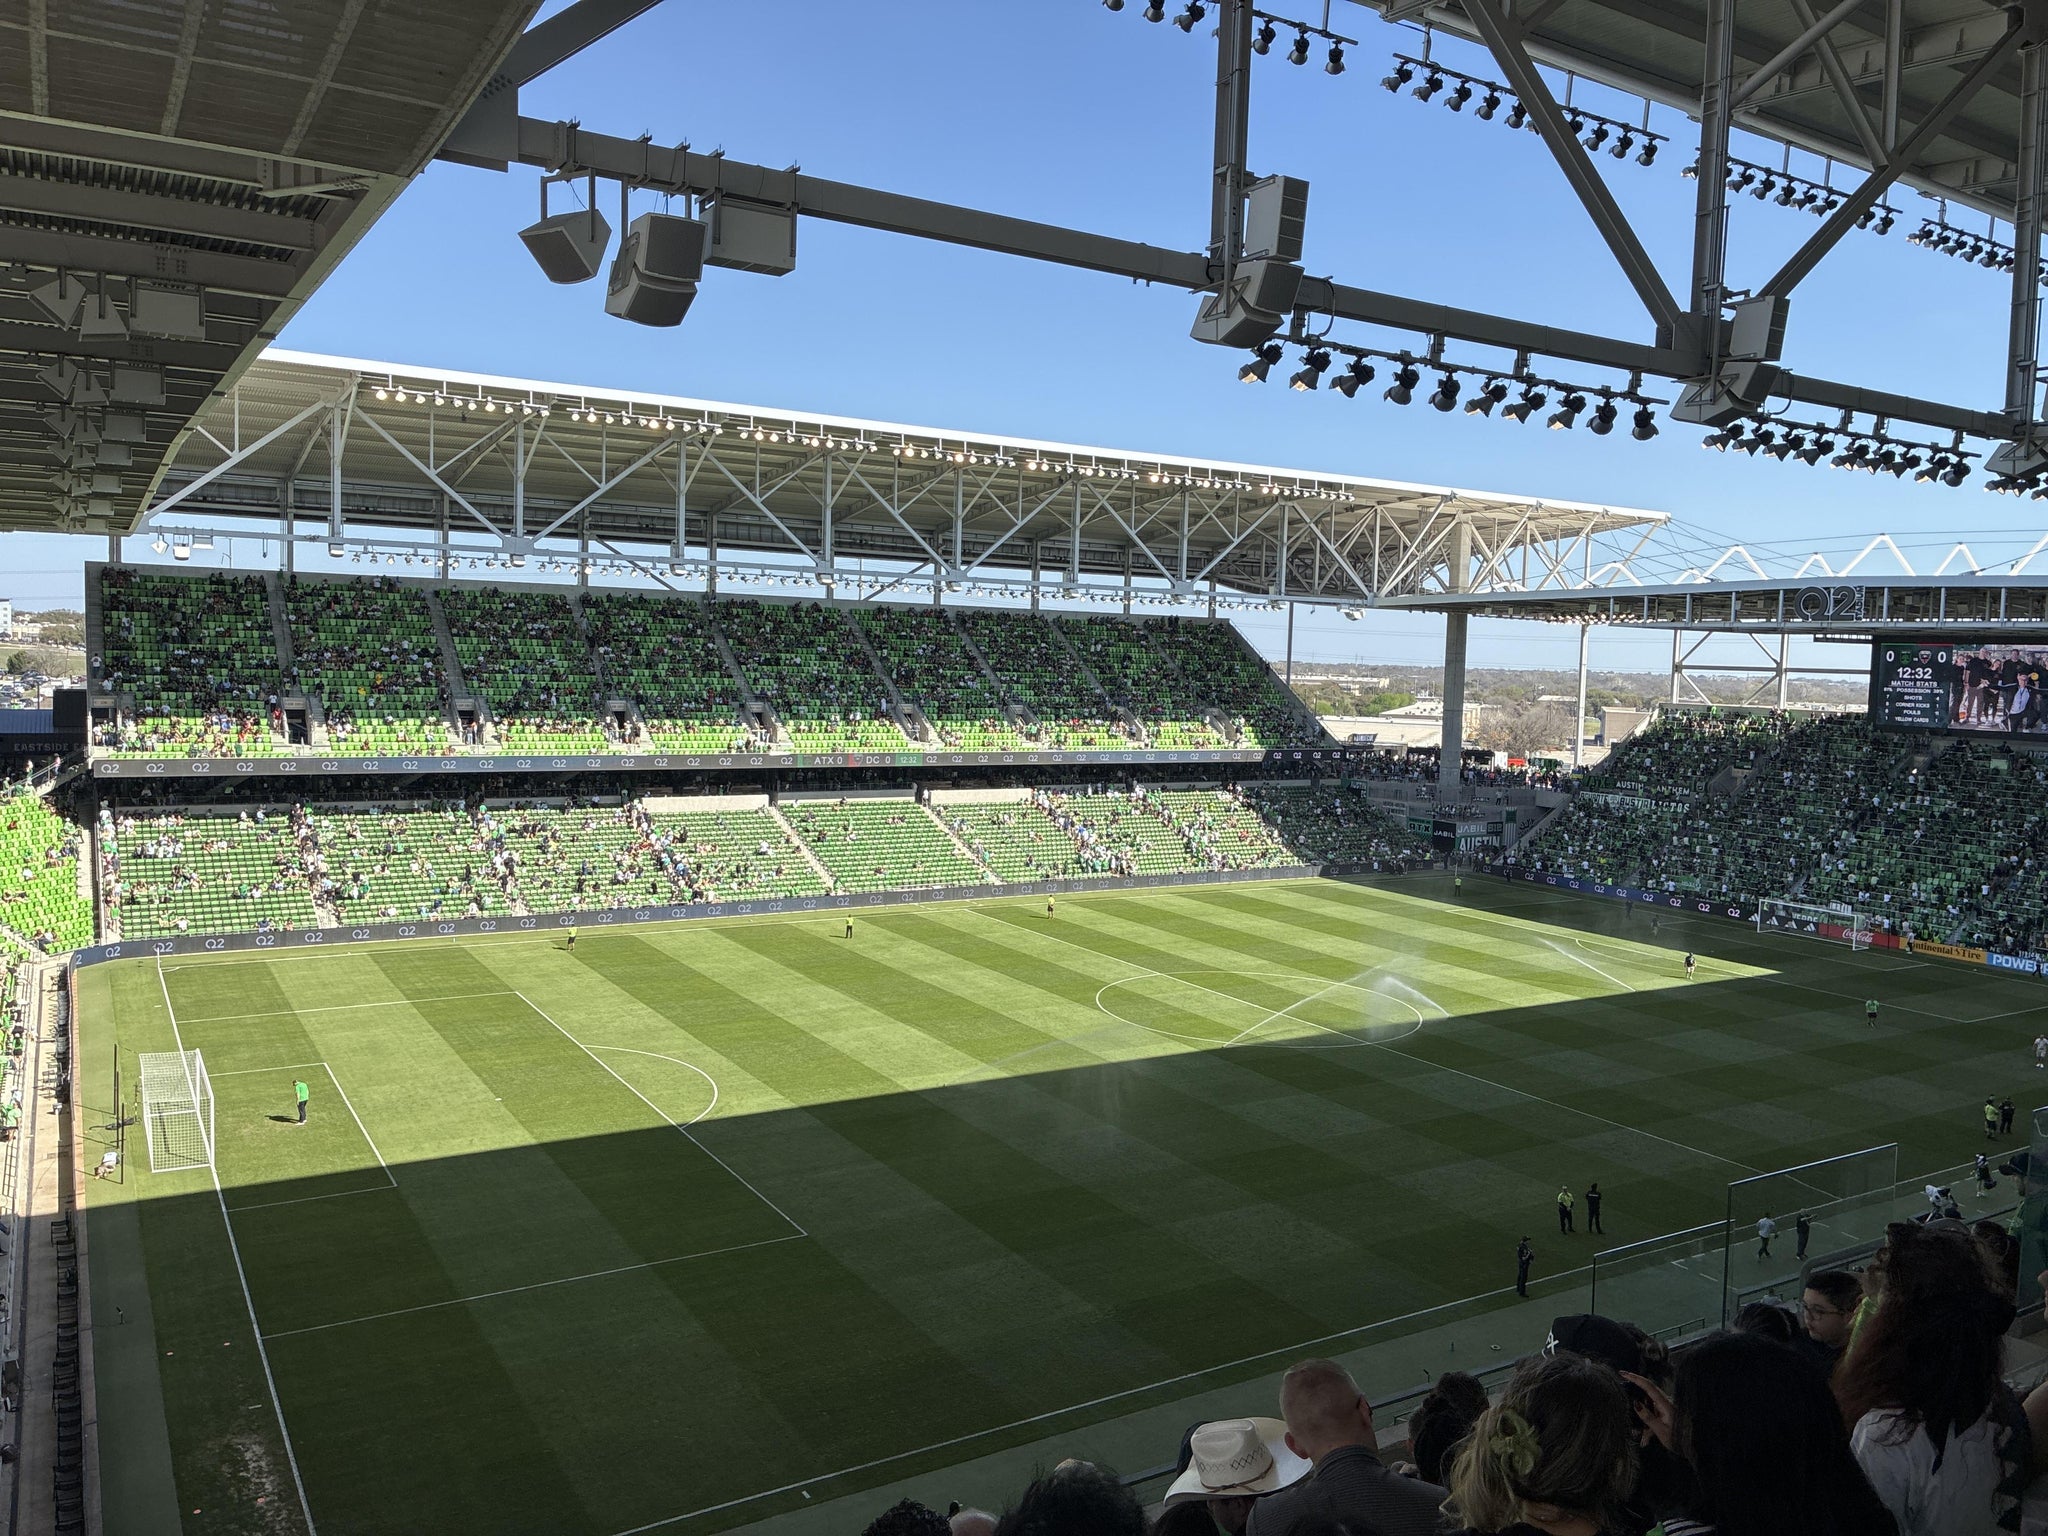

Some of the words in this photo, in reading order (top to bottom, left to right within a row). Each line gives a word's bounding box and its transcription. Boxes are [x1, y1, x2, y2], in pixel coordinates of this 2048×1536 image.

[1794, 585, 1856, 622] Q2
[1856, 585, 1865, 620] STADIUM
[1886, 650, 1894, 662] 0
[1938, 652, 1946, 663] 0
[1897, 667, 1932, 679] 12:32
[14, 743, 69, 752] EASTSIDE
[101, 764, 119, 773] Q2
[146, 764, 164, 772] Q2
[192, 763, 209, 772] Q2
[236, 762, 253, 771] Q2
[280, 762, 296, 771] Q2
[322, 762, 338, 770] Q2
[363, 761, 378, 770] Q2
[402, 761, 418, 769] Q2
[441, 760, 456, 769] Q2
[479, 760, 494, 768] Q2
[517, 760, 531, 768] Q2
[552, 759, 566, 767] Q2
[621, 758, 634, 766] Q2
[654, 758, 668, 766] Q2
[687, 758, 700, 766] Q2
[1458, 825, 1486, 833] JABIL
[1460, 836, 1500, 851] AUSTIN
[1547, 876, 1556, 884] Q2
[1570, 880, 1579, 888] Q2
[1594, 885, 1604, 893] Q2
[1616, 889, 1627, 897] Q2
[1642, 893, 1654, 902] Q2
[1670, 898, 1681, 906] Q2
[1698, 903, 1710, 912] Q2
[1728, 908, 1740, 917] Q2
[106, 946, 120, 957] Q2
[206, 938, 224, 948] Q2
[256, 935, 274, 945] Q2
[305, 932, 322, 942] Q2
[352, 929, 370, 939] Q2
[399, 926, 416, 936] Q2
[438, 924, 455, 933] Q2
[480, 921, 496, 930] Q2
[520, 918, 536, 928] Q2
[560, 916, 574, 925] Q2
[598, 913, 612, 922] Q2
[635, 911, 650, 920] Q2
[672, 908, 686, 917] Q2
[708, 906, 721, 915] Q2
[738, 904, 752, 912] Q2
[769, 902, 782, 910] Q2
[803, 900, 816, 908] Q2
[836, 897, 850, 906] Q2
[870, 895, 882, 903] Q2
[902, 893, 914, 902] Q2
[932, 891, 944, 899] Q2
[962, 889, 974, 897] Q2
[992, 887, 1003, 895] Q2
[1021, 885, 1032, 894] Q2
[1913, 942, 1953, 954] ontinental
[1960, 949, 1981, 960] Tire
